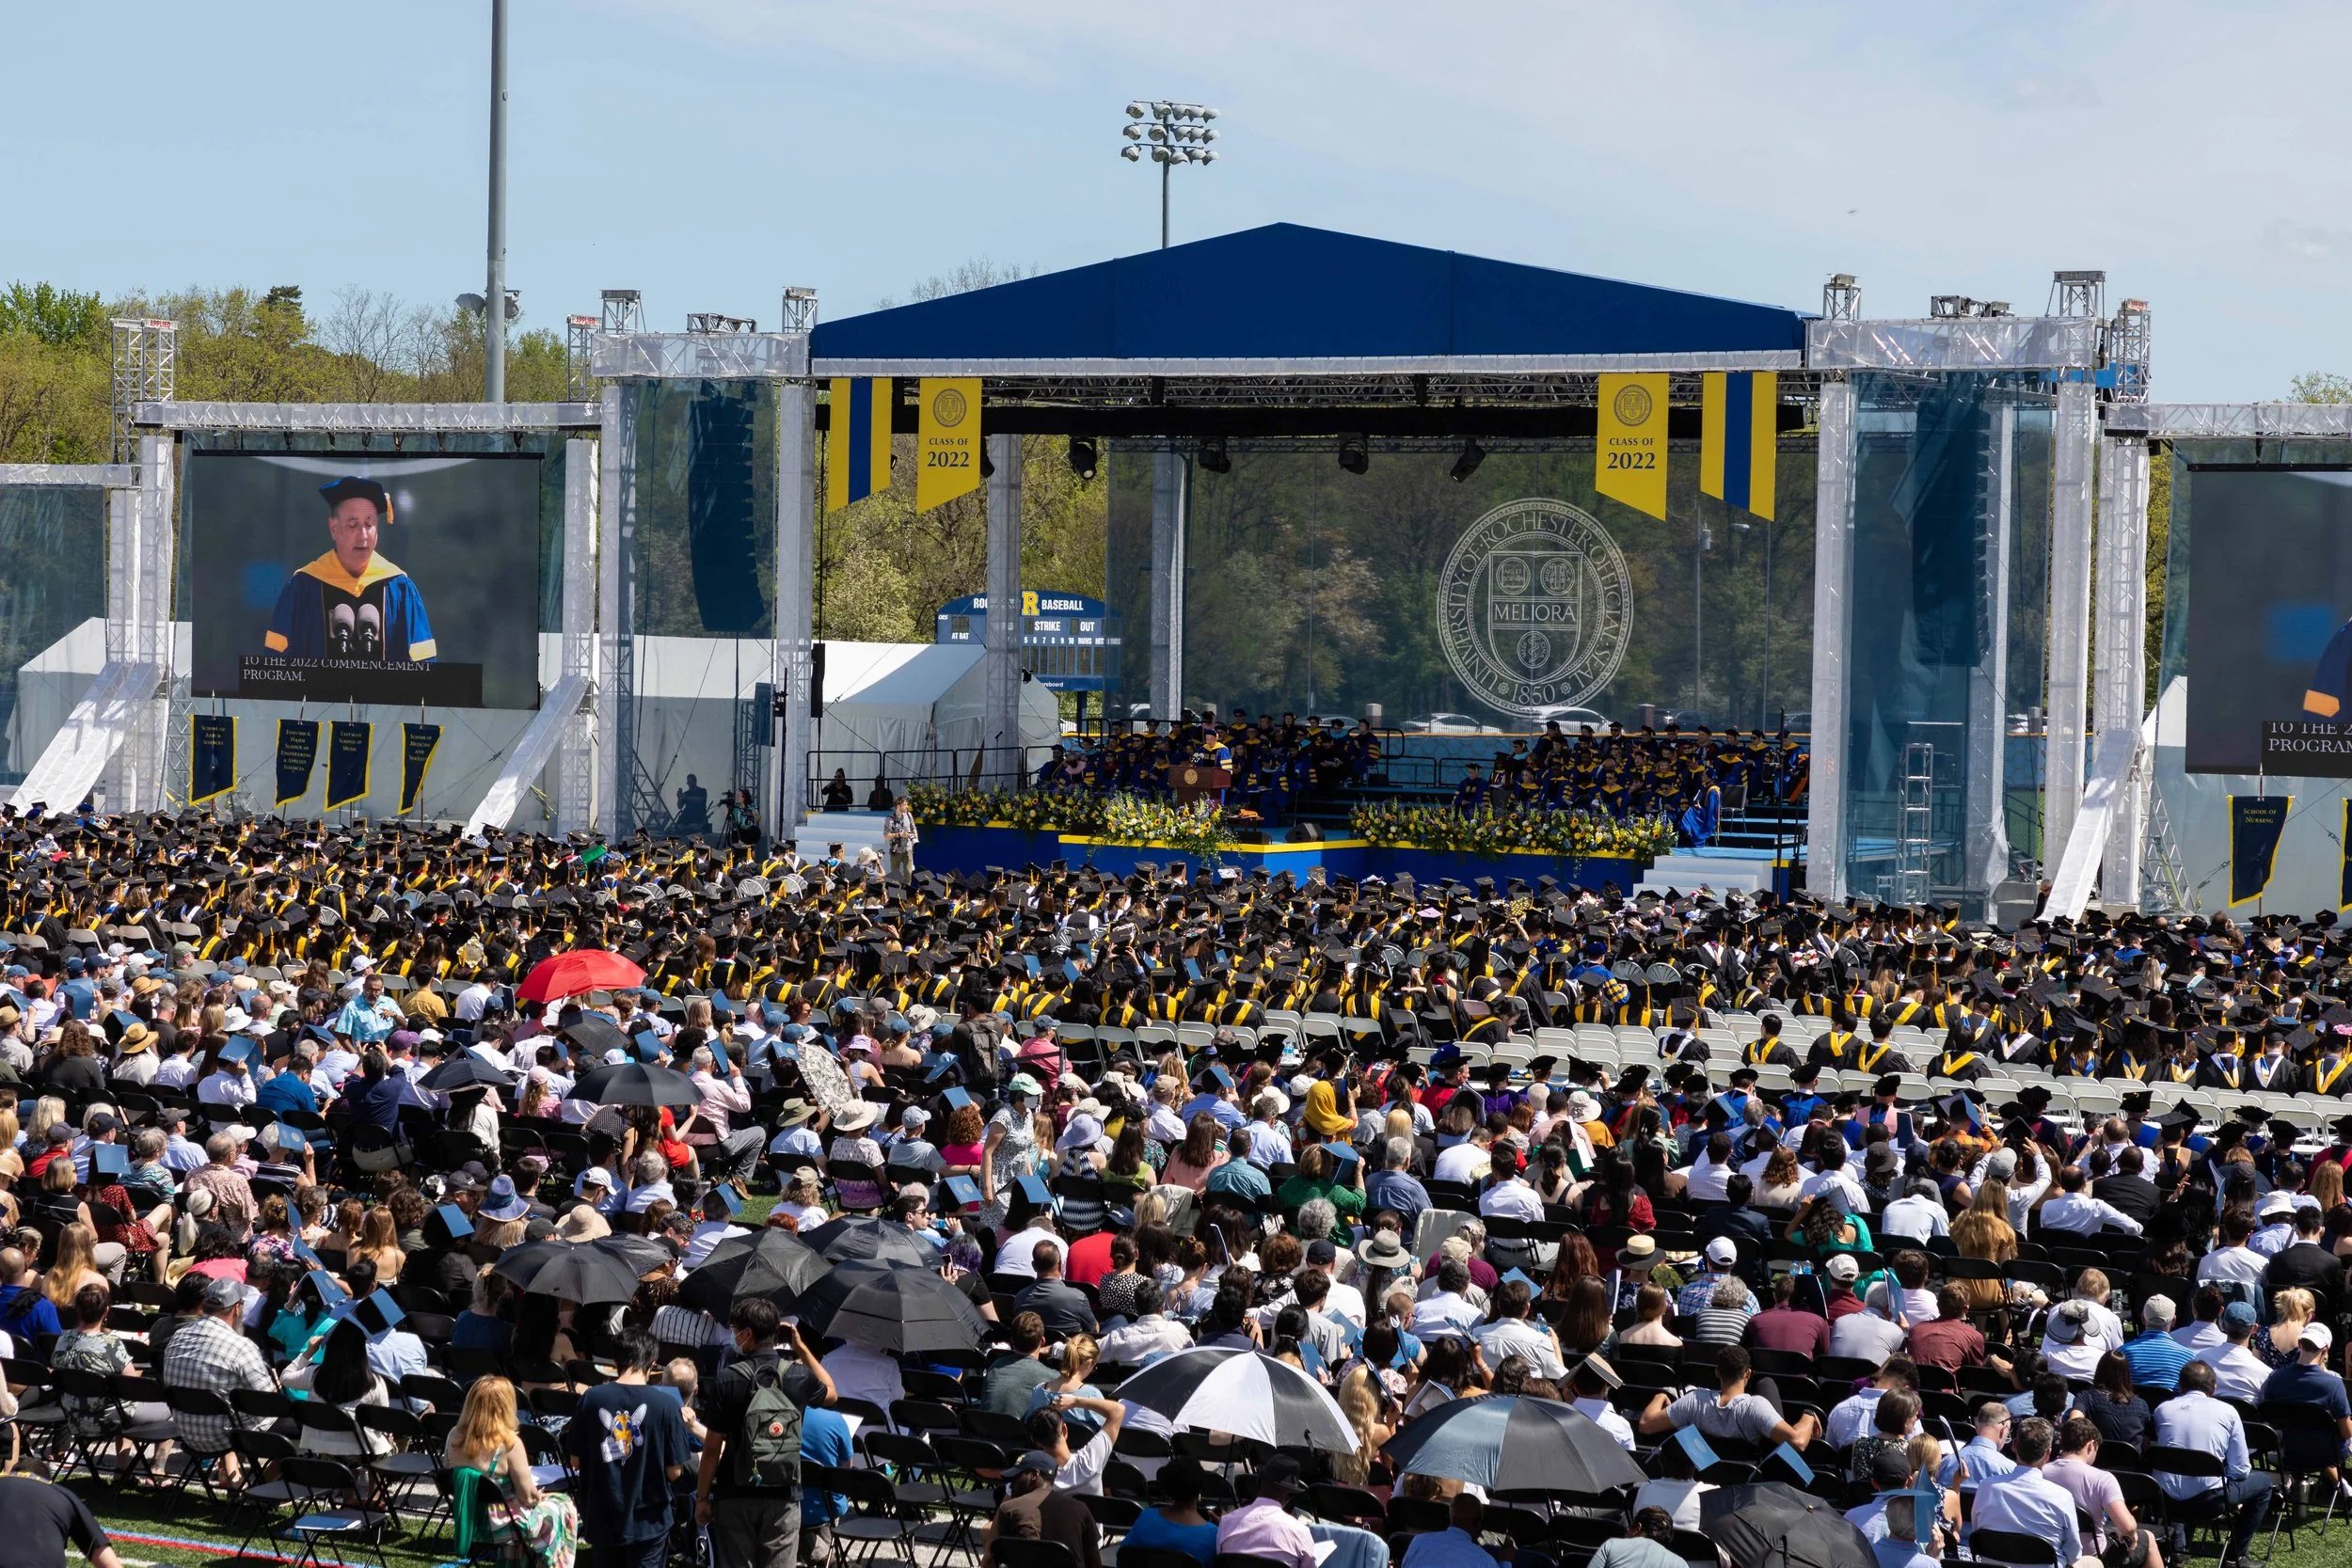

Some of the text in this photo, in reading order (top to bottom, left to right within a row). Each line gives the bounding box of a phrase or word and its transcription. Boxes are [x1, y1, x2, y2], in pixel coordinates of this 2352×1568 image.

[927, 451, 969, 467] 2022
[1607, 452, 1656, 469] 2022
[1480, 511, 1593, 551] ROCHESTER
[1460, 543, 1482, 573] OF
[1589, 545, 1621, 641] OFFICIAL
[1022, 591, 1039, 616] R
[1041, 599, 1084, 610] BASEBALL
[1494, 604, 1576, 621] MELIORA
[1035, 621, 1095, 631] STRIKE OUT
[1449, 573, 1498, 691] UNIVERSITY
[244, 656, 431, 671] TO THE 2022 COMMENCEMENT
[1569, 648, 1611, 688] SEAL
[243, 669, 305, 681] PROGRAM.
[1512, 684, 1556, 705] 1850
[2268, 722, 2293, 733] TO
[2299, 723, 2337, 735] THE
